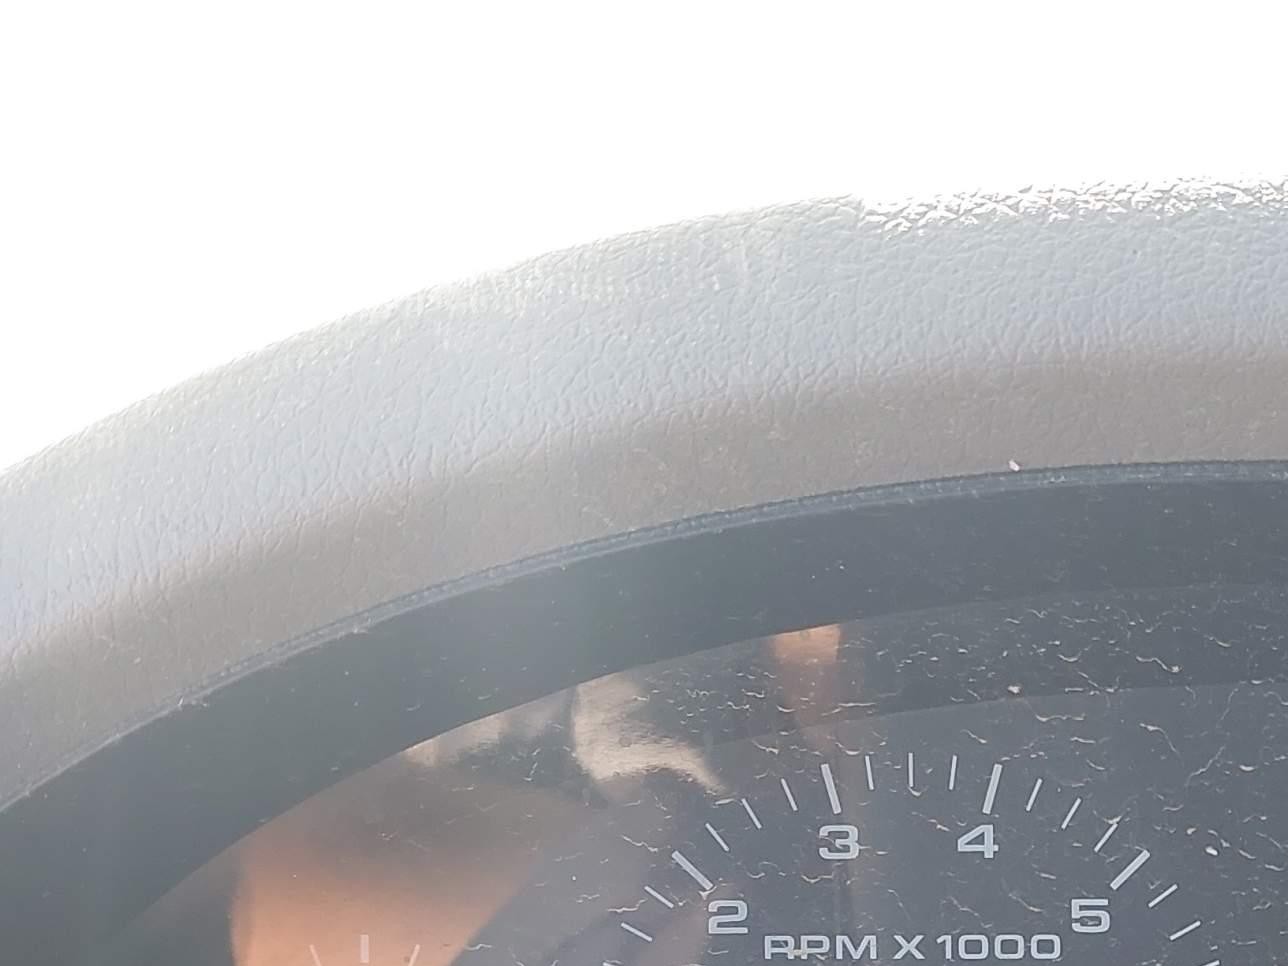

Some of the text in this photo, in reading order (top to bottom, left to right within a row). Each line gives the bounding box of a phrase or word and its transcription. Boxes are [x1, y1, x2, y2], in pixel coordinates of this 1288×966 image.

[818, 824, 860, 860] 3
[957, 824, 999, 859] 4
[707, 900, 749, 935] 2
[1071, 898, 1111, 935] 5
[763, 934, 1062, 960] RPM X 1000
